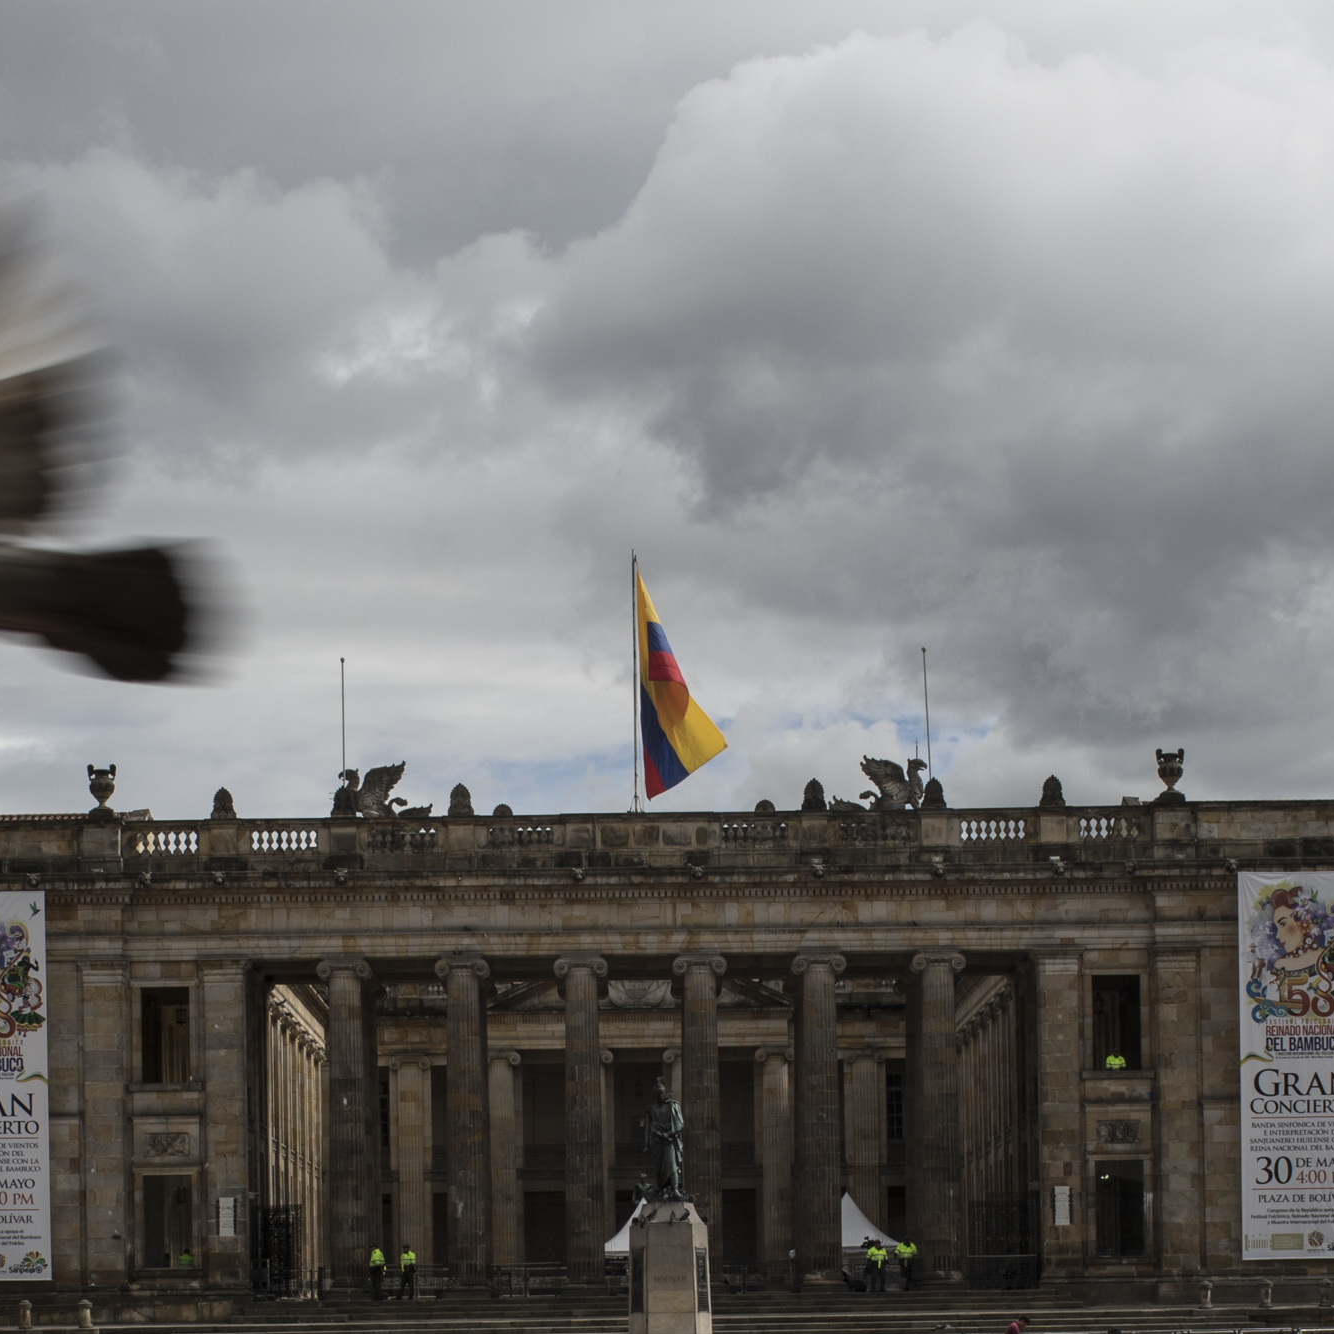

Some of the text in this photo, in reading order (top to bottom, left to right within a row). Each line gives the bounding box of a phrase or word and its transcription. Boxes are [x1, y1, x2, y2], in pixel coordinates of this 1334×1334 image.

[1265, 1025, 1300, 1036] REINADO
[1266, 1037, 1287, 1052] DEL
[1277, 1120, 1315, 1128] SINFÓNICA
[1269, 1128, 1329, 1136] INTERPRETACIÓN
[1255, 1156, 1293, 1185] 30
[1295, 1157, 1312, 1168] DE
[1295, 1170, 1327, 1184] 4:00
[12, 1193, 35, 1205] PM
[1258, 1194, 1290, 1203] PLAZA
[1292, 1193, 1306, 1202] DE
